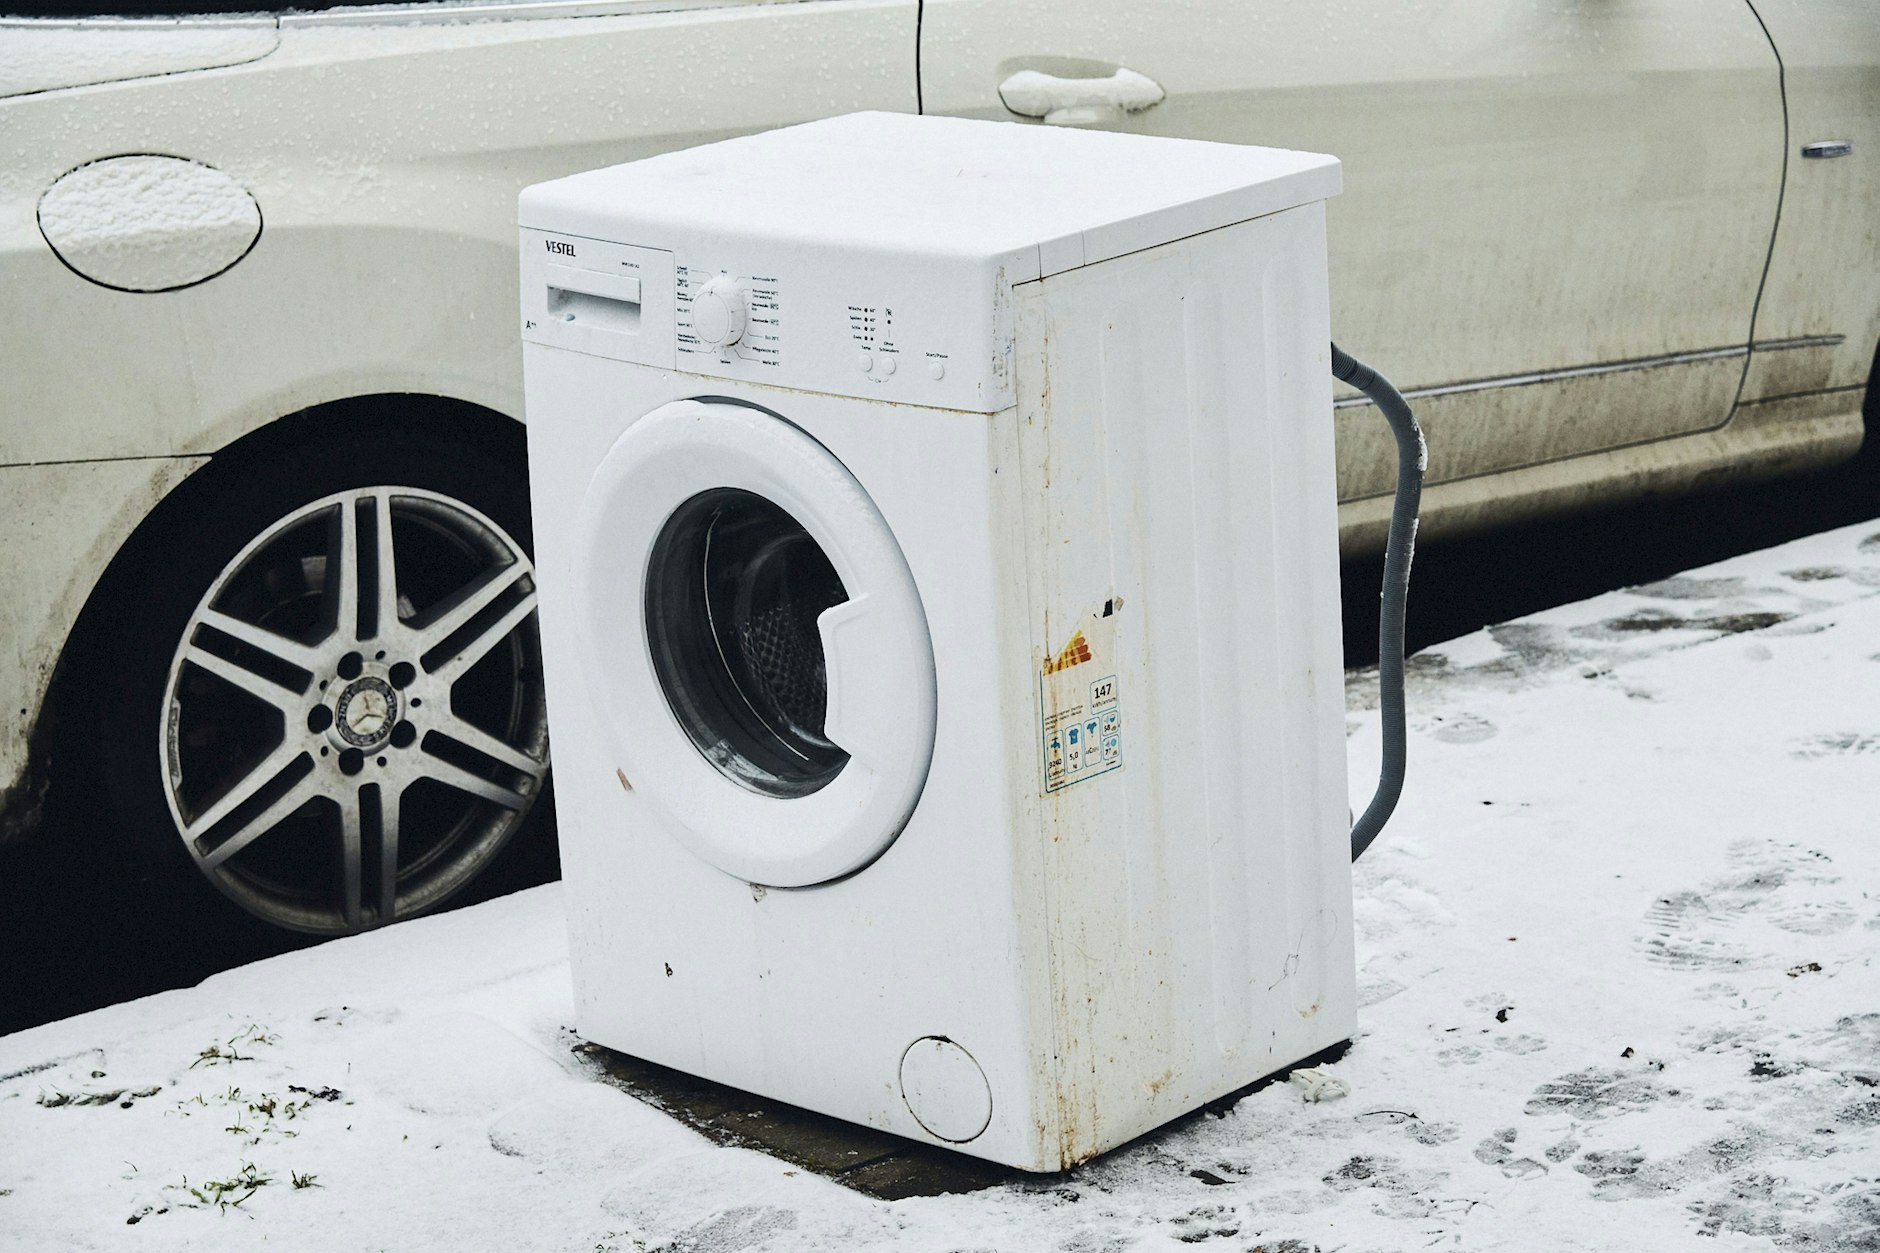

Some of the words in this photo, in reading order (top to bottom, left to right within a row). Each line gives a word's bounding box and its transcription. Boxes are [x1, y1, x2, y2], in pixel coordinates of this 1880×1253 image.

[545, 240, 576, 257] VESTEL
[1094, 682, 1112, 699] 147
[1103, 724, 1111, 733] 58
[1069, 751, 1079, 761] 5,0
